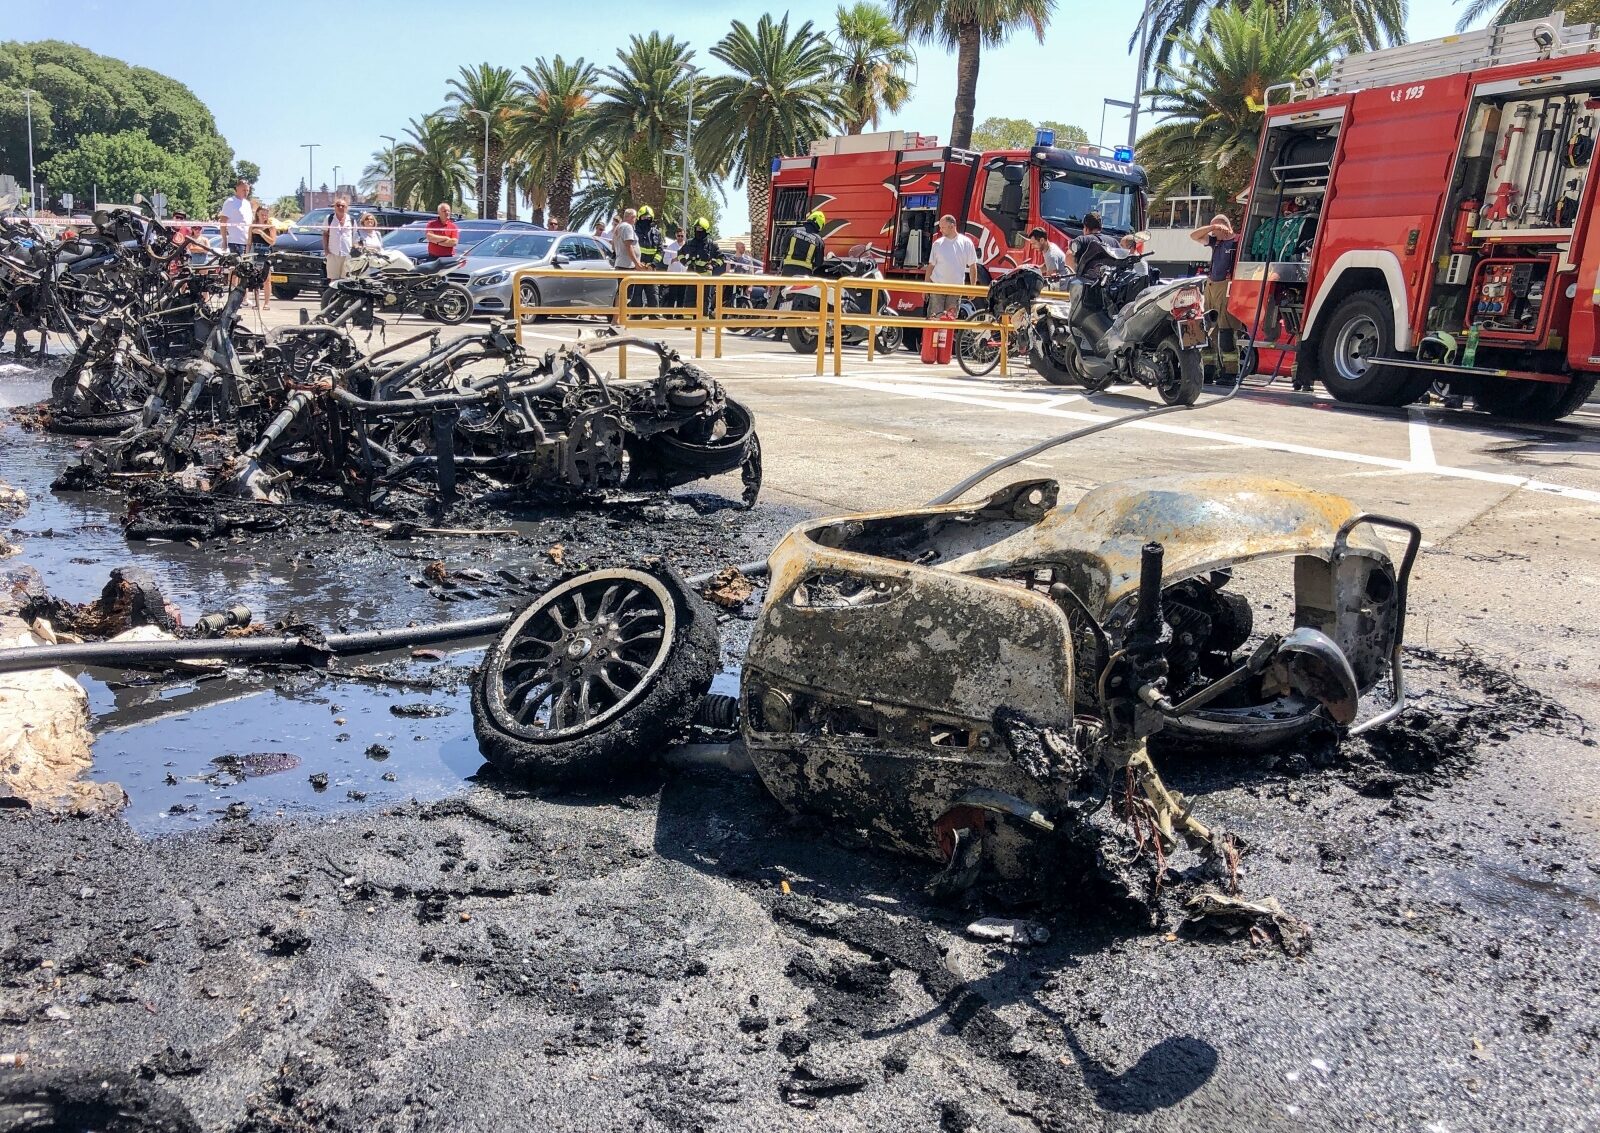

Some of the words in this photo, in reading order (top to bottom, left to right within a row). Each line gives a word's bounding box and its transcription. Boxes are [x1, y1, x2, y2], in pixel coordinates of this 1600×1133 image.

[1405, 85, 1425, 101] 193
[1075, 155, 1099, 169] DVD
[1100, 161, 1128, 175] SPLIT
